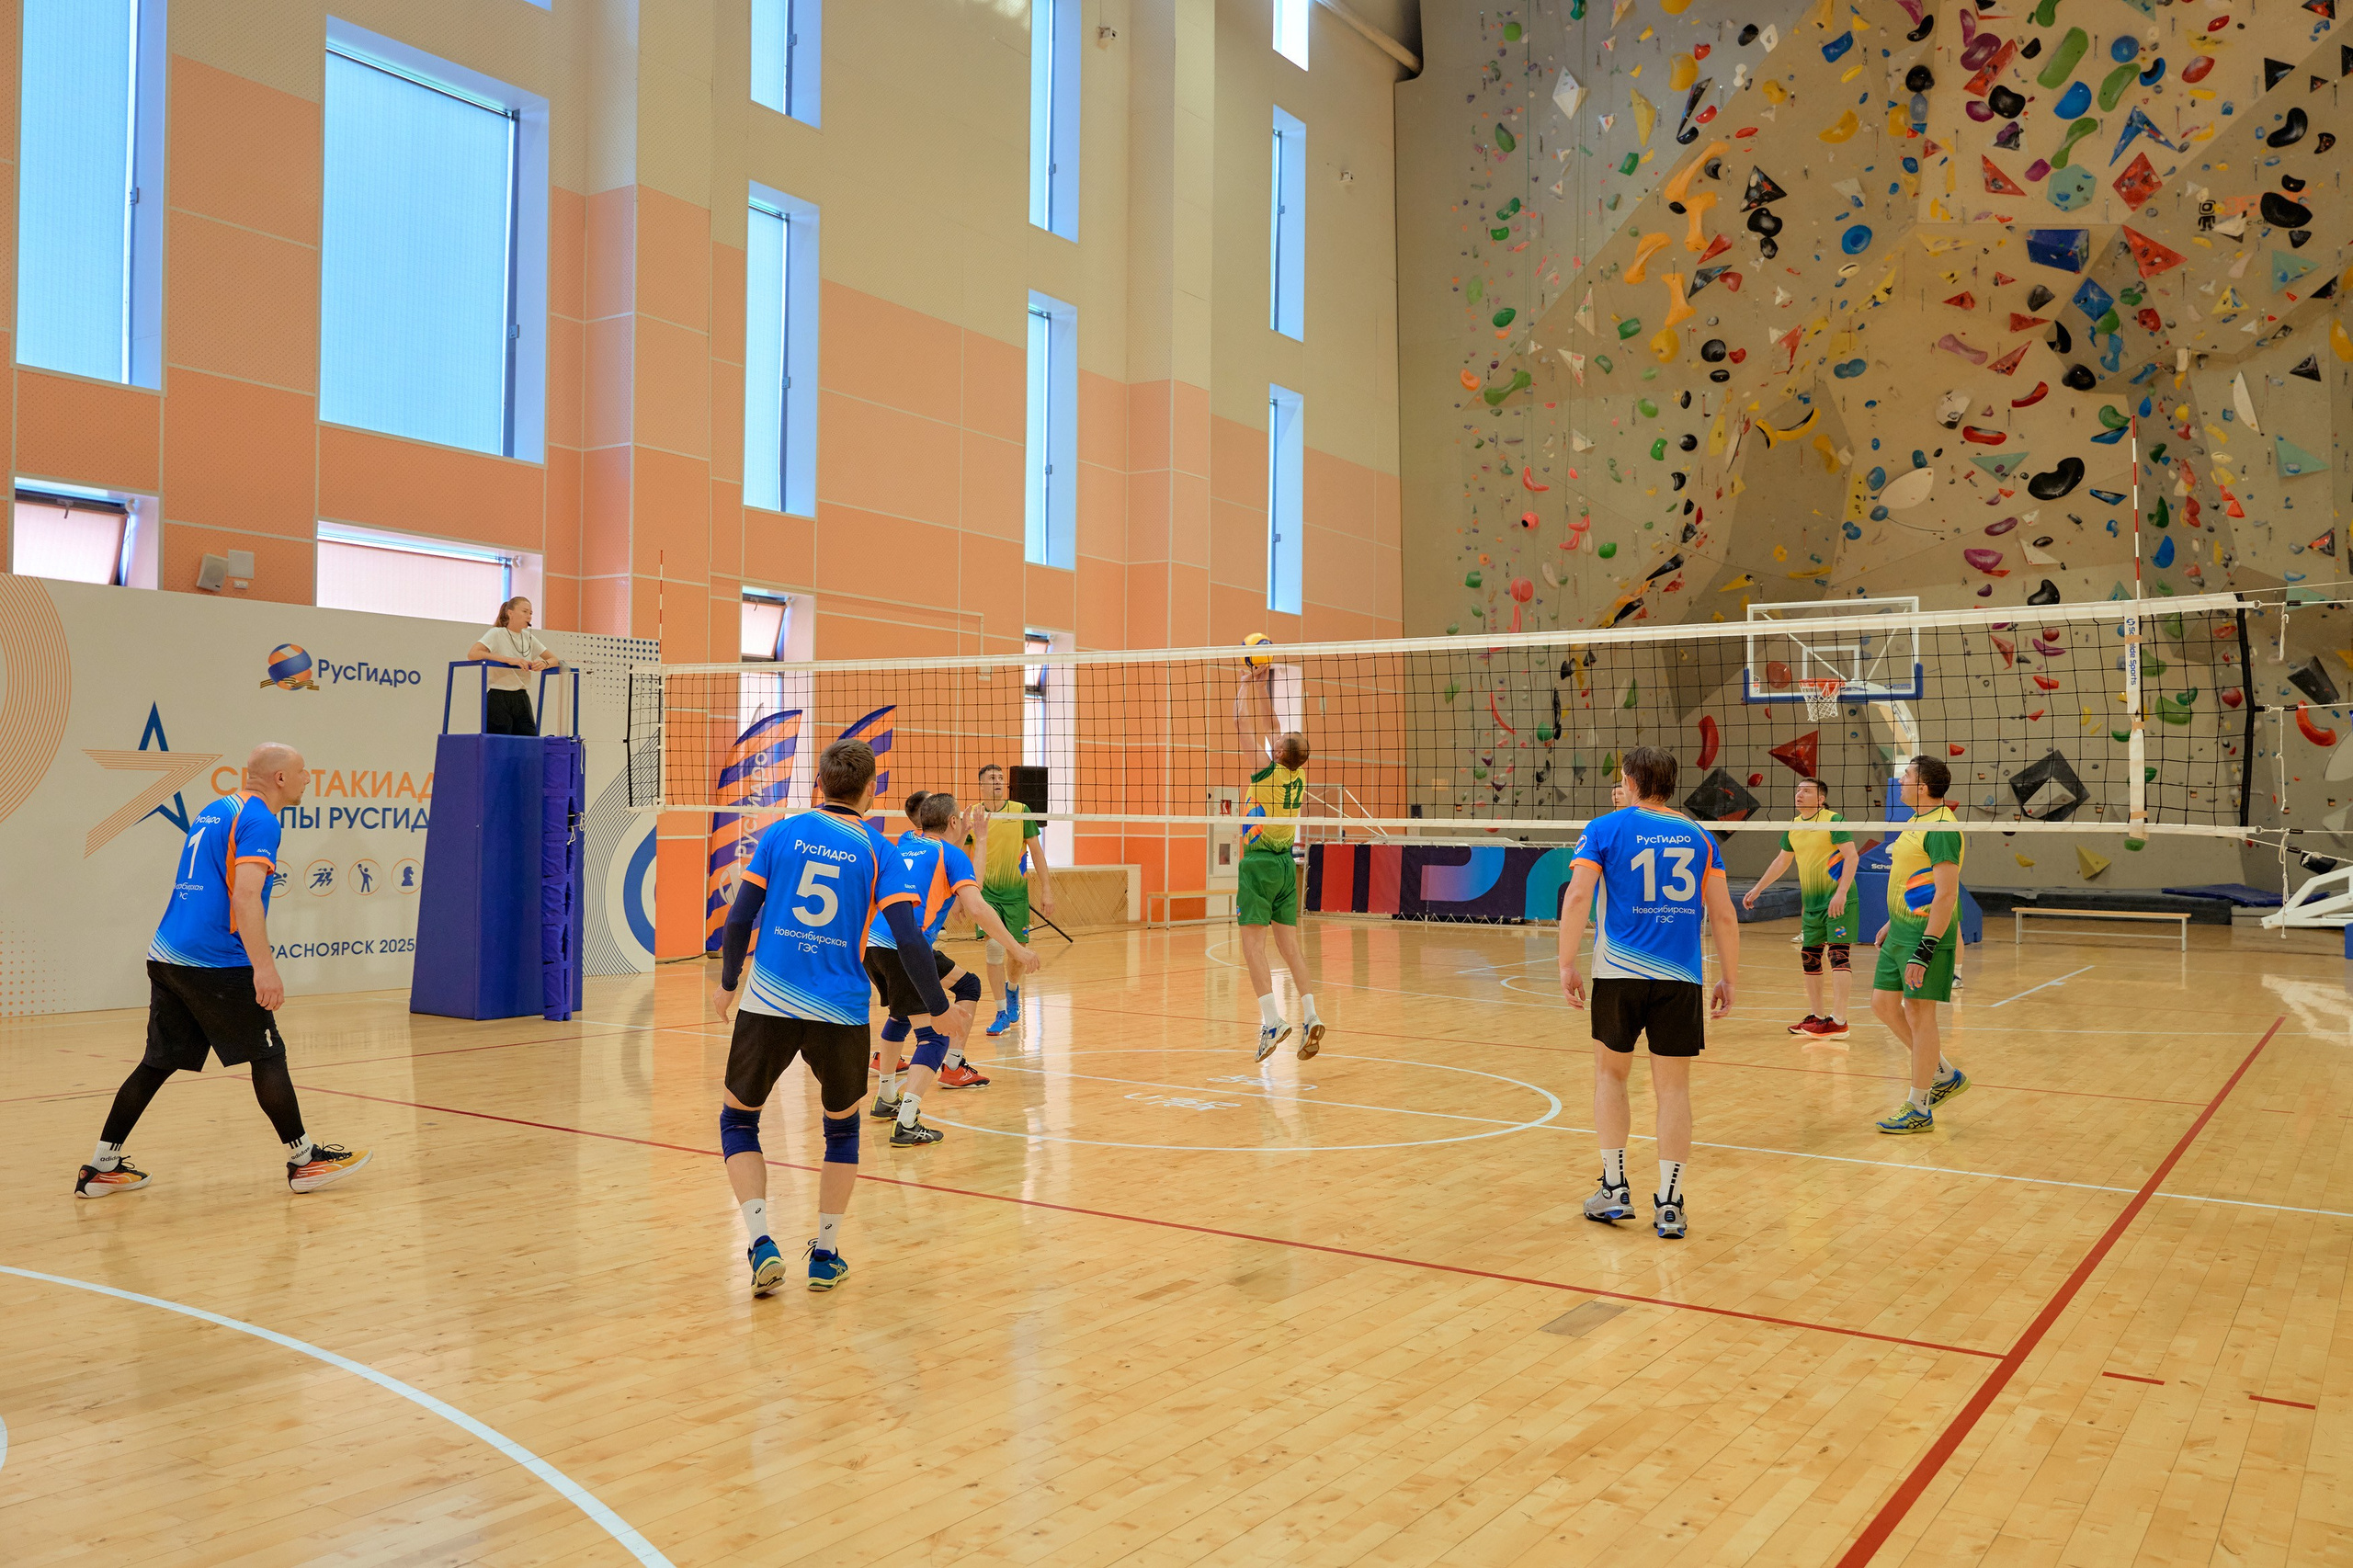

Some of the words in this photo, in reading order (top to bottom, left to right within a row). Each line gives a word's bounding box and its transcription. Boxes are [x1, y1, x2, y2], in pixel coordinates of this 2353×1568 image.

[318, 658, 421, 687] РусГидро
[2130, 659, 2138, 686] Sports
[210, 766, 435, 803] СТАКИАД
[1282, 777, 1304, 810] 12
[794, 839, 857, 863] РусГидро
[1636, 835, 1691, 846] РусГидро
[188, 826, 206, 880] 1
[1631, 847, 1696, 902] 13
[791, 859, 840, 927] 5
[1632, 905, 1696, 915] Новосибирская
[1655, 915, 1674, 924] ГЭС
[380, 938, 415, 953] 2025
[774, 926, 847, 949] Новосибирская
[798, 942, 819, 954] ГЭС
[265, 1028, 274, 1048] 1
[290, 1146, 311, 1160] adidas
